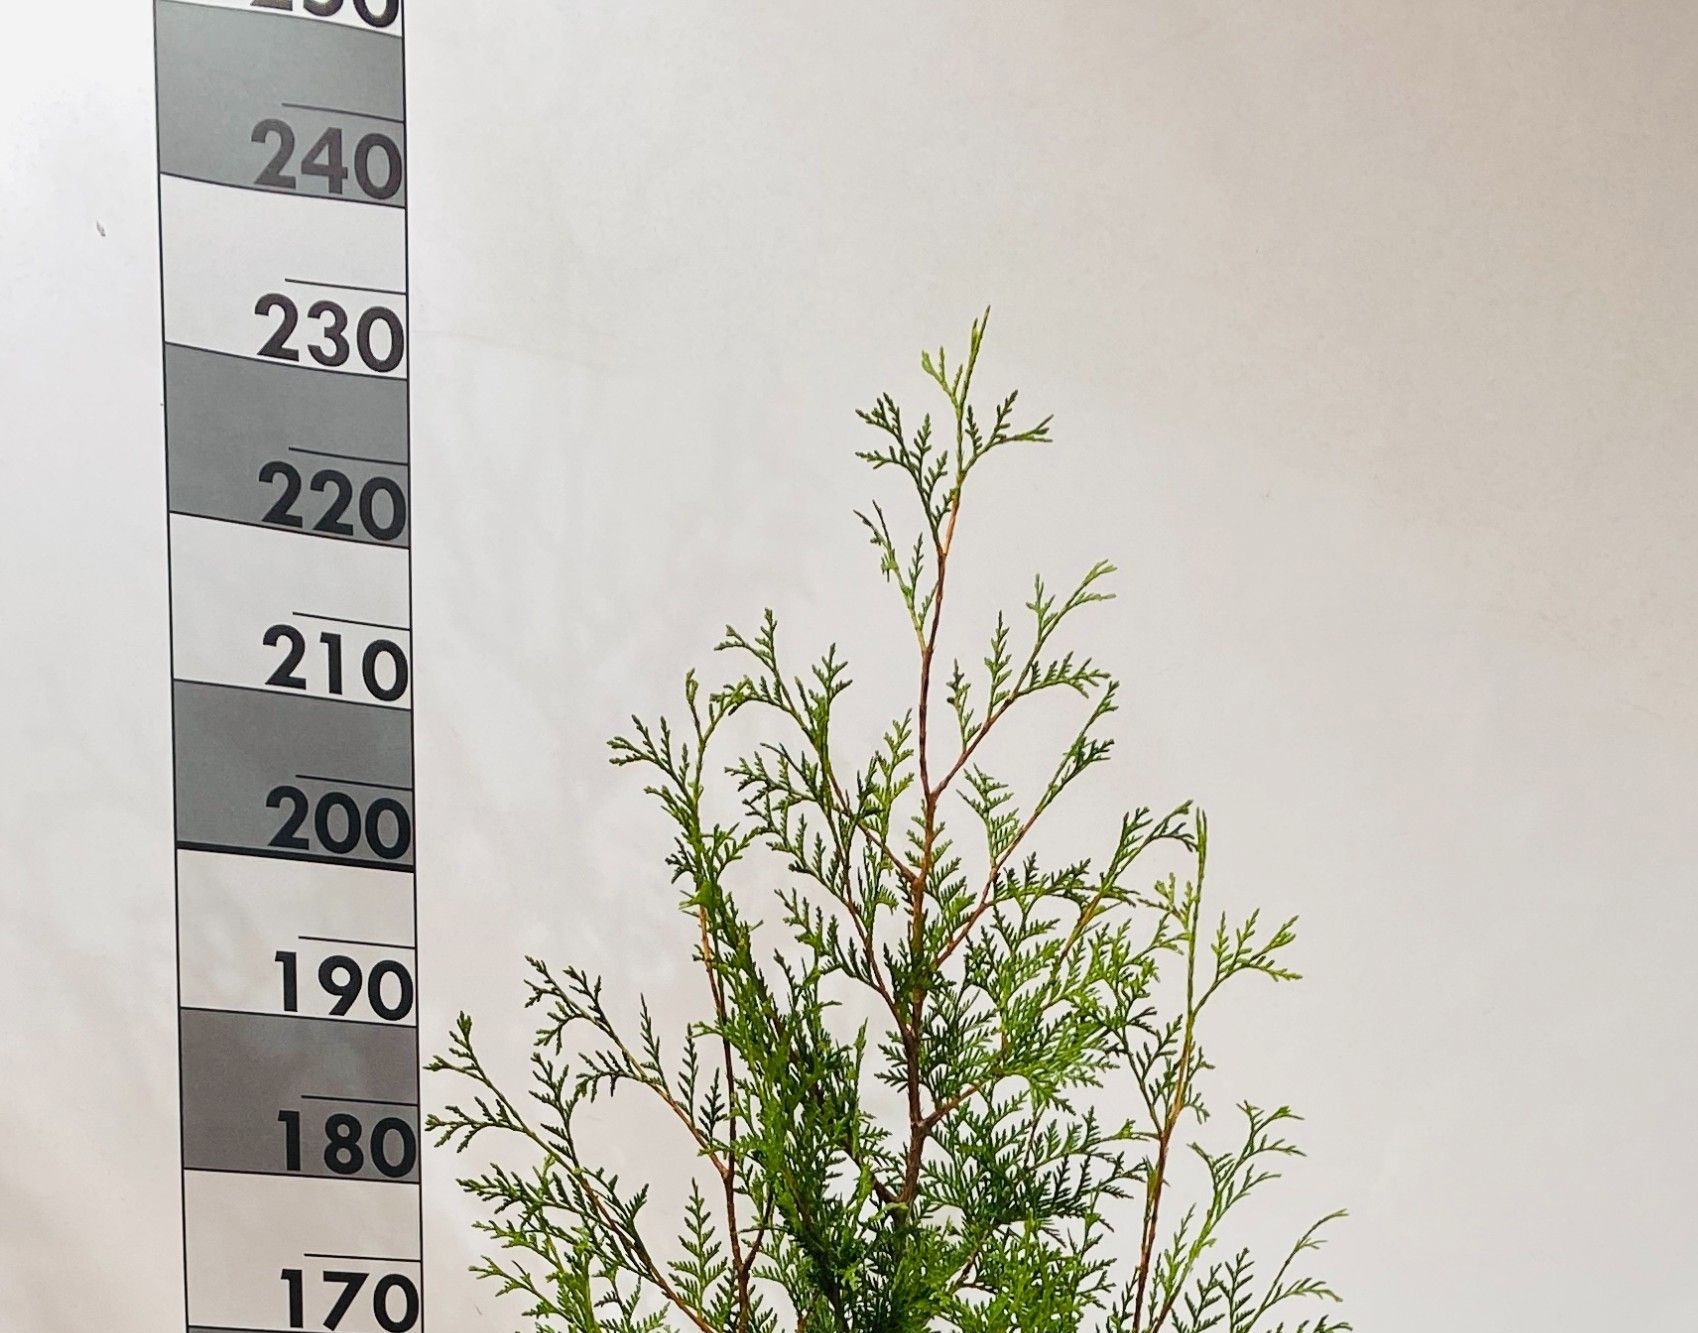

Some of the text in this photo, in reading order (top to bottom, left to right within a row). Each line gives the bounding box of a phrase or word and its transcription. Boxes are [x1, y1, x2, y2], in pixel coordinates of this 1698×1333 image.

[250, 118, 401, 200] 240
[254, 293, 403, 373] 230
[258, 461, 407, 541] 220
[262, 624, 409, 702] 210
[265, 785, 411, 860] 200
[274, 950, 414, 1022] 190
[278, 1110, 417, 1178] 180
[281, 1269, 420, 1333] 170
